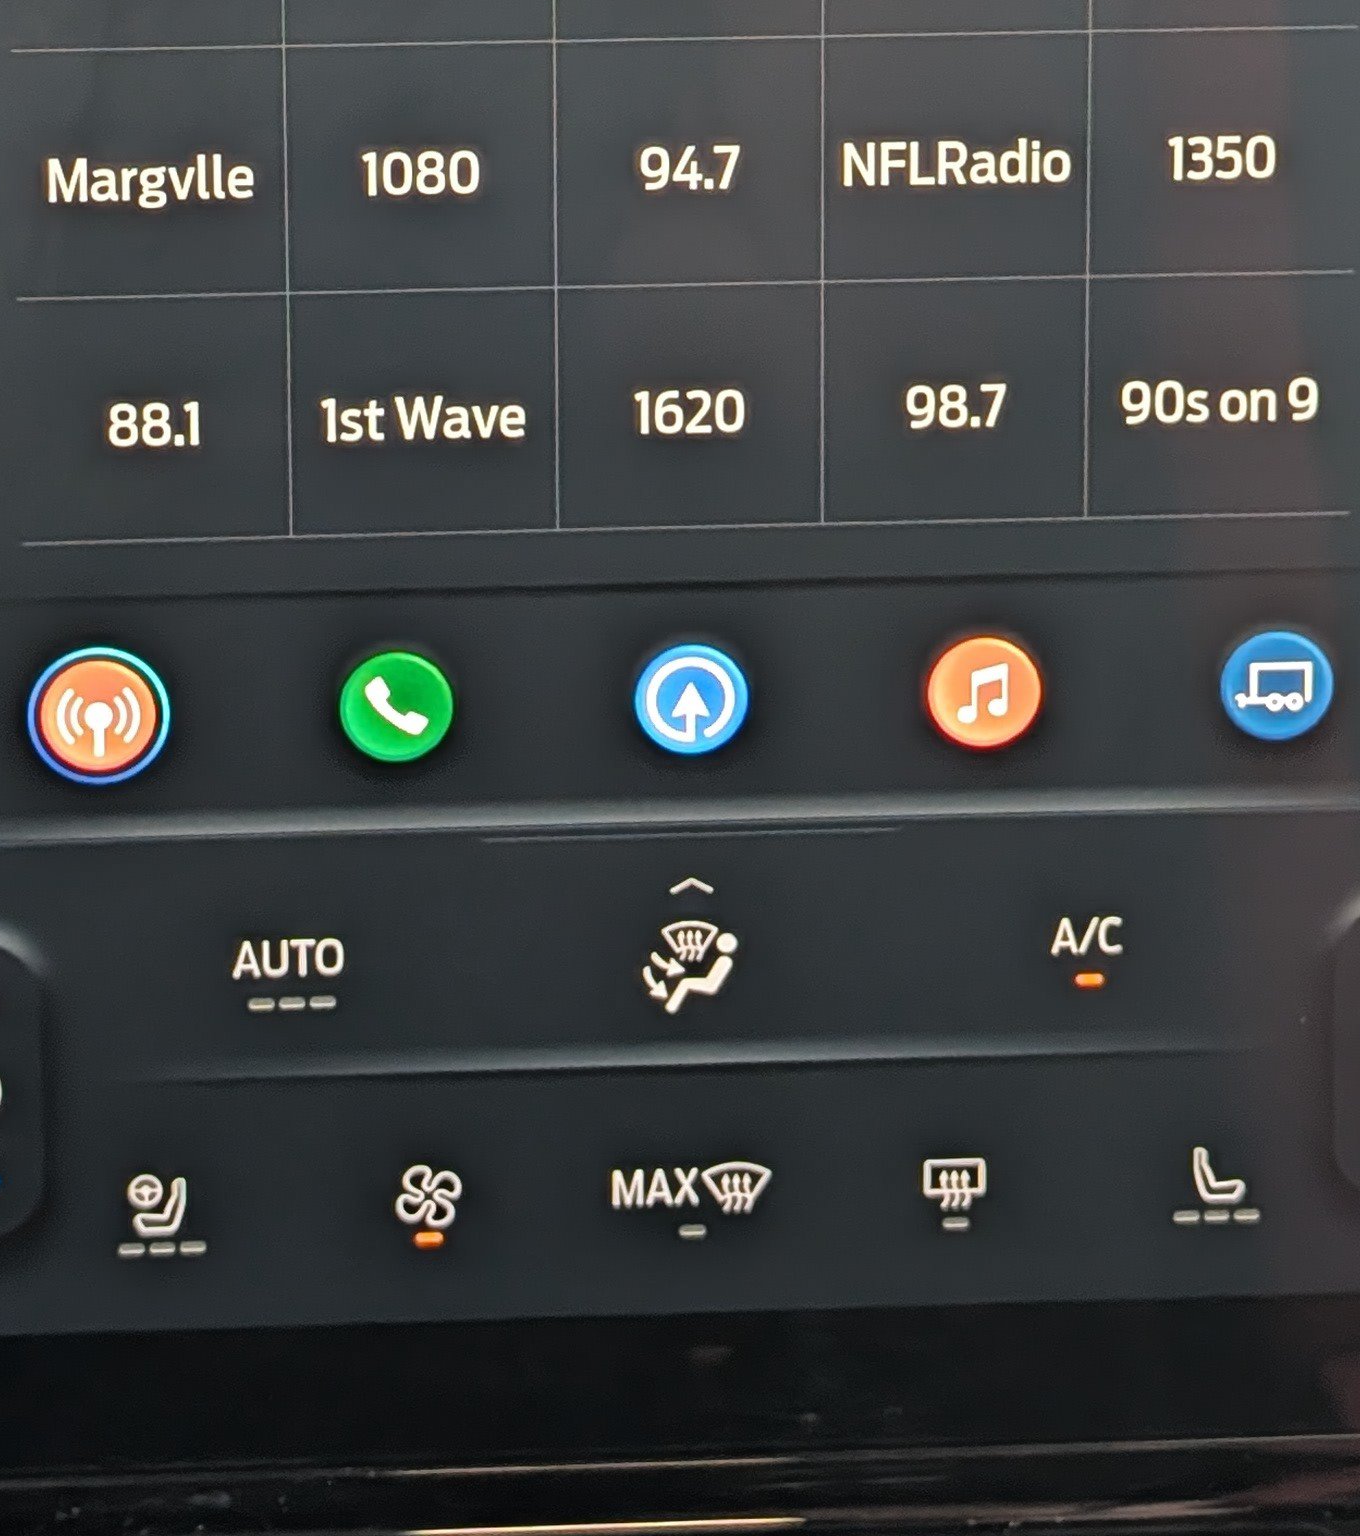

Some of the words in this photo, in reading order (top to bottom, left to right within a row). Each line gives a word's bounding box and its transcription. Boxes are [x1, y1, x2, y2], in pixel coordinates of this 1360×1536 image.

[48, 153, 255, 209] Margvlle
[361, 150, 480, 197] 1080
[640, 144, 741, 191] 94.7
[843, 137, 1071, 187] NFLRadio
[1168, 135, 1276, 181] 1350
[108, 401, 200, 447] 88.1
[320, 397, 384, 443] 1st
[394, 395, 526, 440] Wave
[634, 388, 745, 435] 1620
[906, 383, 1007, 429] 98.7
[1121, 379, 1210, 425] 90s
[1219, 388, 1277, 422] on
[1288, 376, 1319, 421] 9
[232, 938, 345, 980] AUTO
[1050, 916, 1123, 956] A/C
[611, 1167, 700, 1208] MAX
